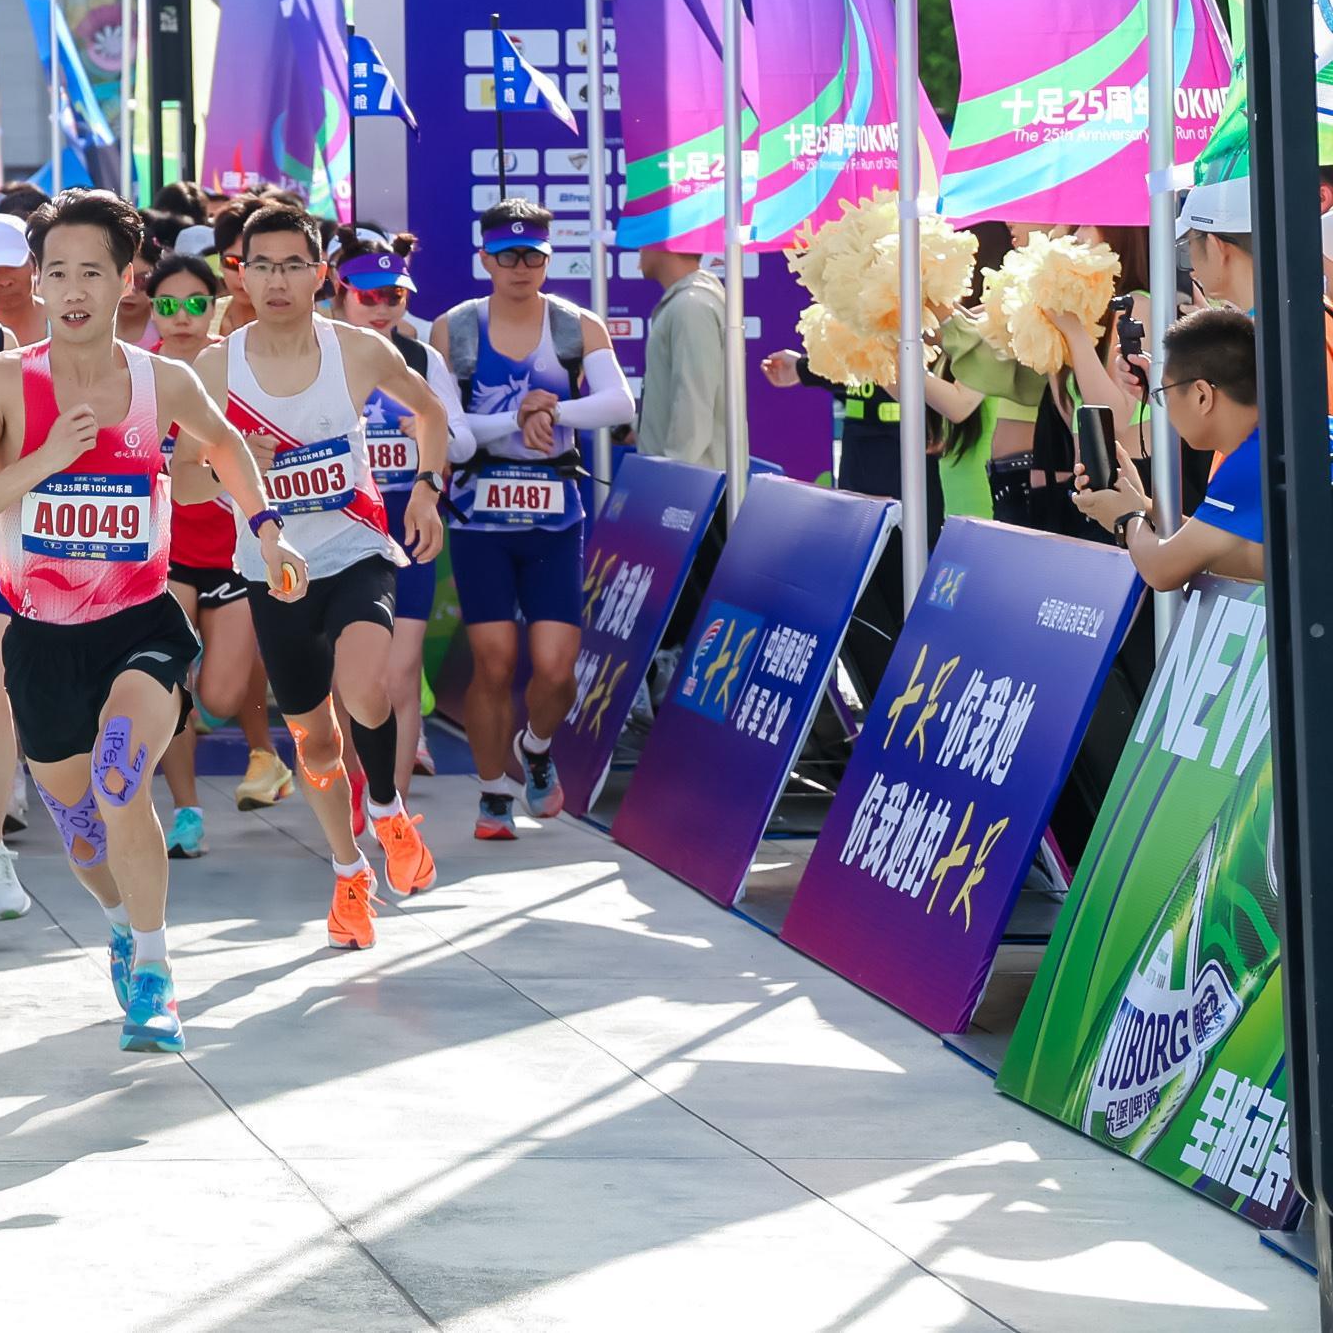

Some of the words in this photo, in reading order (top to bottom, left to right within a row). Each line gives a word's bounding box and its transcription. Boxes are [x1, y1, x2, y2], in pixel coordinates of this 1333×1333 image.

[1013, 128, 1039, 142] The
[46, 482, 132, 494] 十足25周年10KM乐跑
[486, 484, 552, 510] A1487
[33, 501, 141, 540] A0049
[760, 623, 819, 686] 中国便利店
[736, 682, 794, 746] 领军企业
[1097, 1003, 1192, 1091] TUBORG
